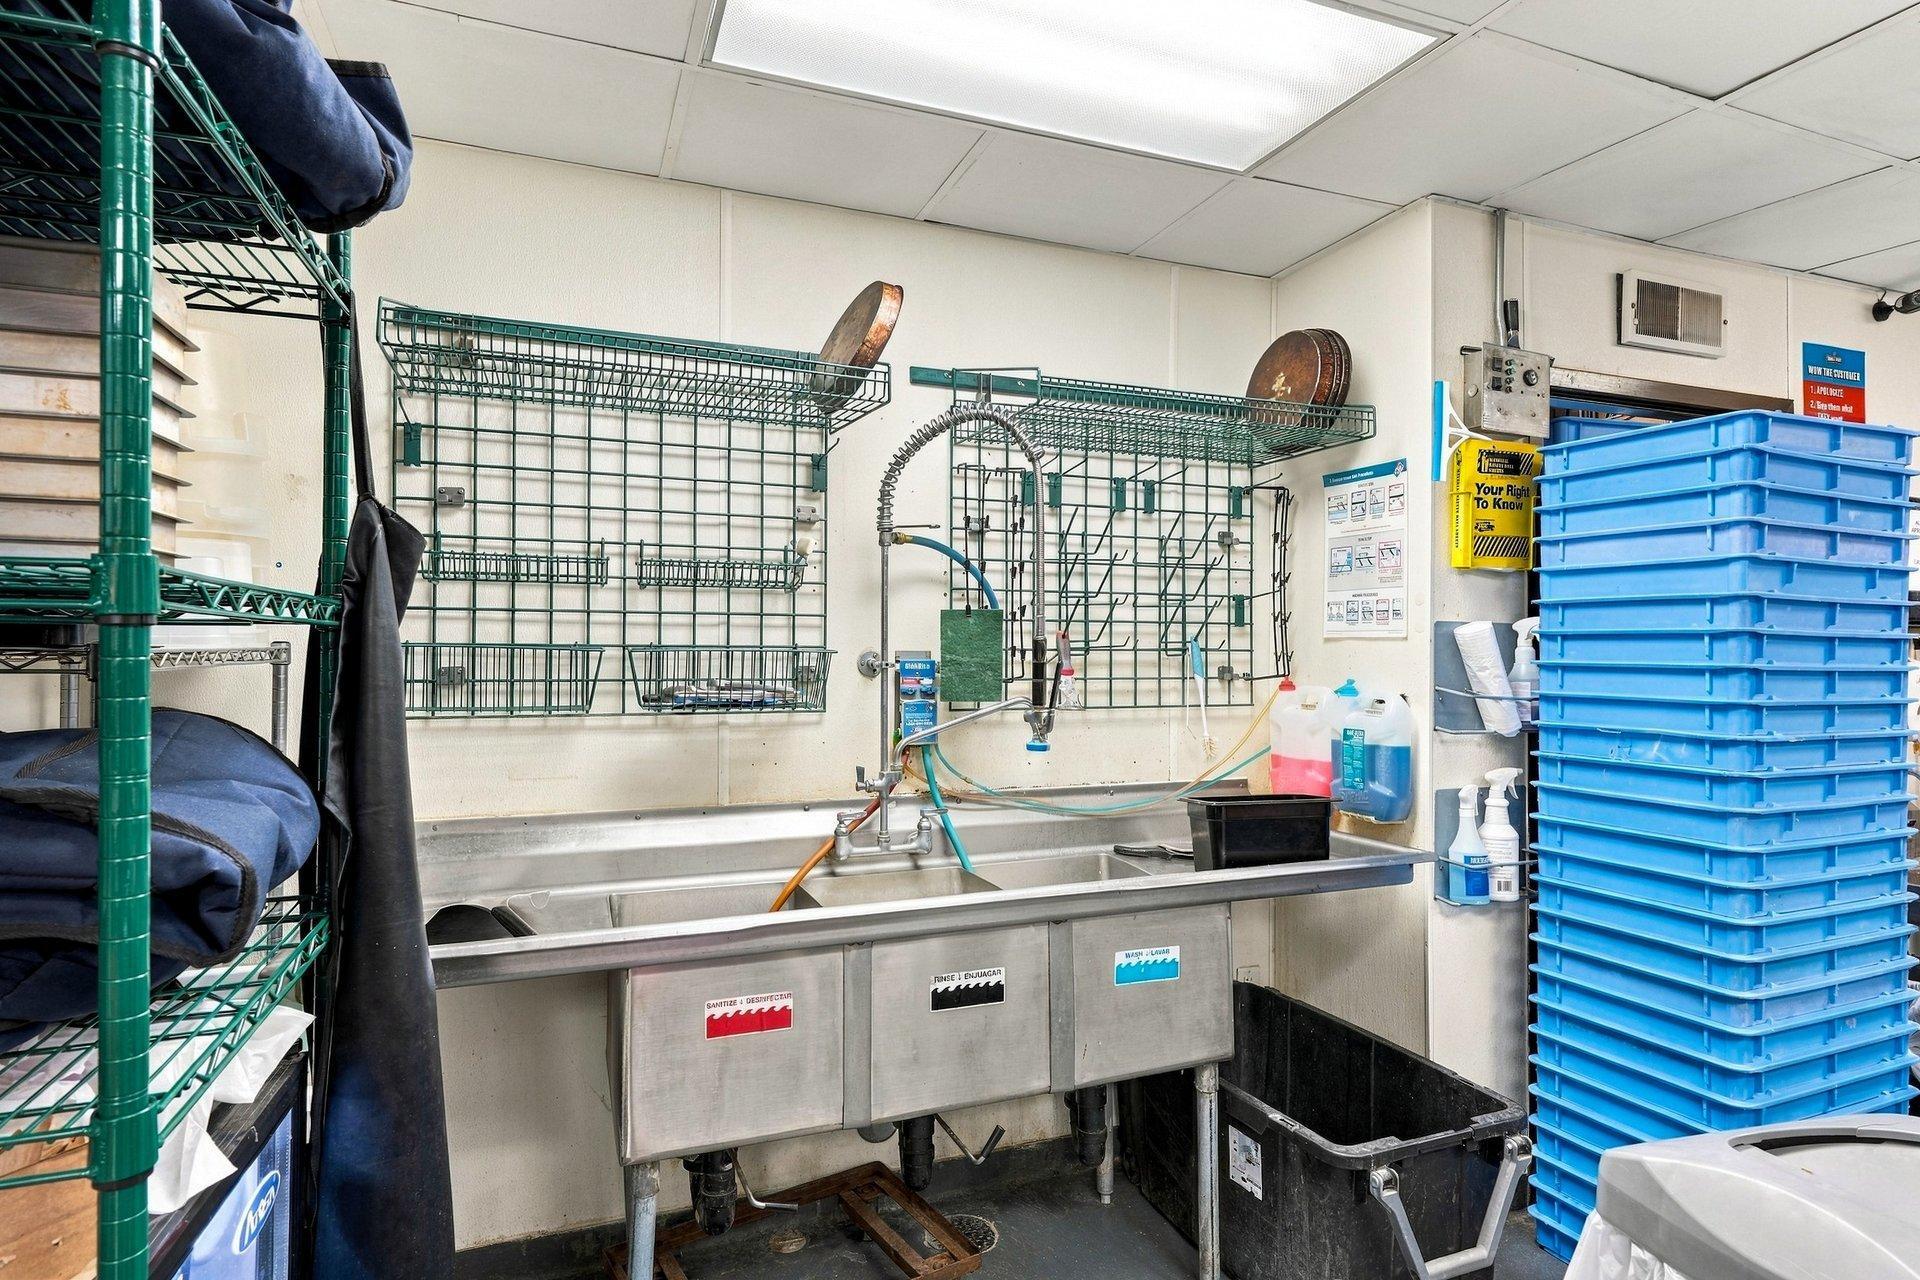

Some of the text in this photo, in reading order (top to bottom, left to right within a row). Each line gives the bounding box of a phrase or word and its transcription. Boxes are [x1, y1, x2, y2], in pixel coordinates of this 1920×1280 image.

[1833, 369, 1860, 381] CUSTOMER
[1475, 483, 1530, 498] Your Right
[1475, 497, 1523, 511] To Know
[1125, 948, 1170, 959] WASH LAVAR
[934, 969, 1001, 983] RINSE ENJUAGAR
[706, 992, 792, 1009] SANITIZE DESINFECTAR
